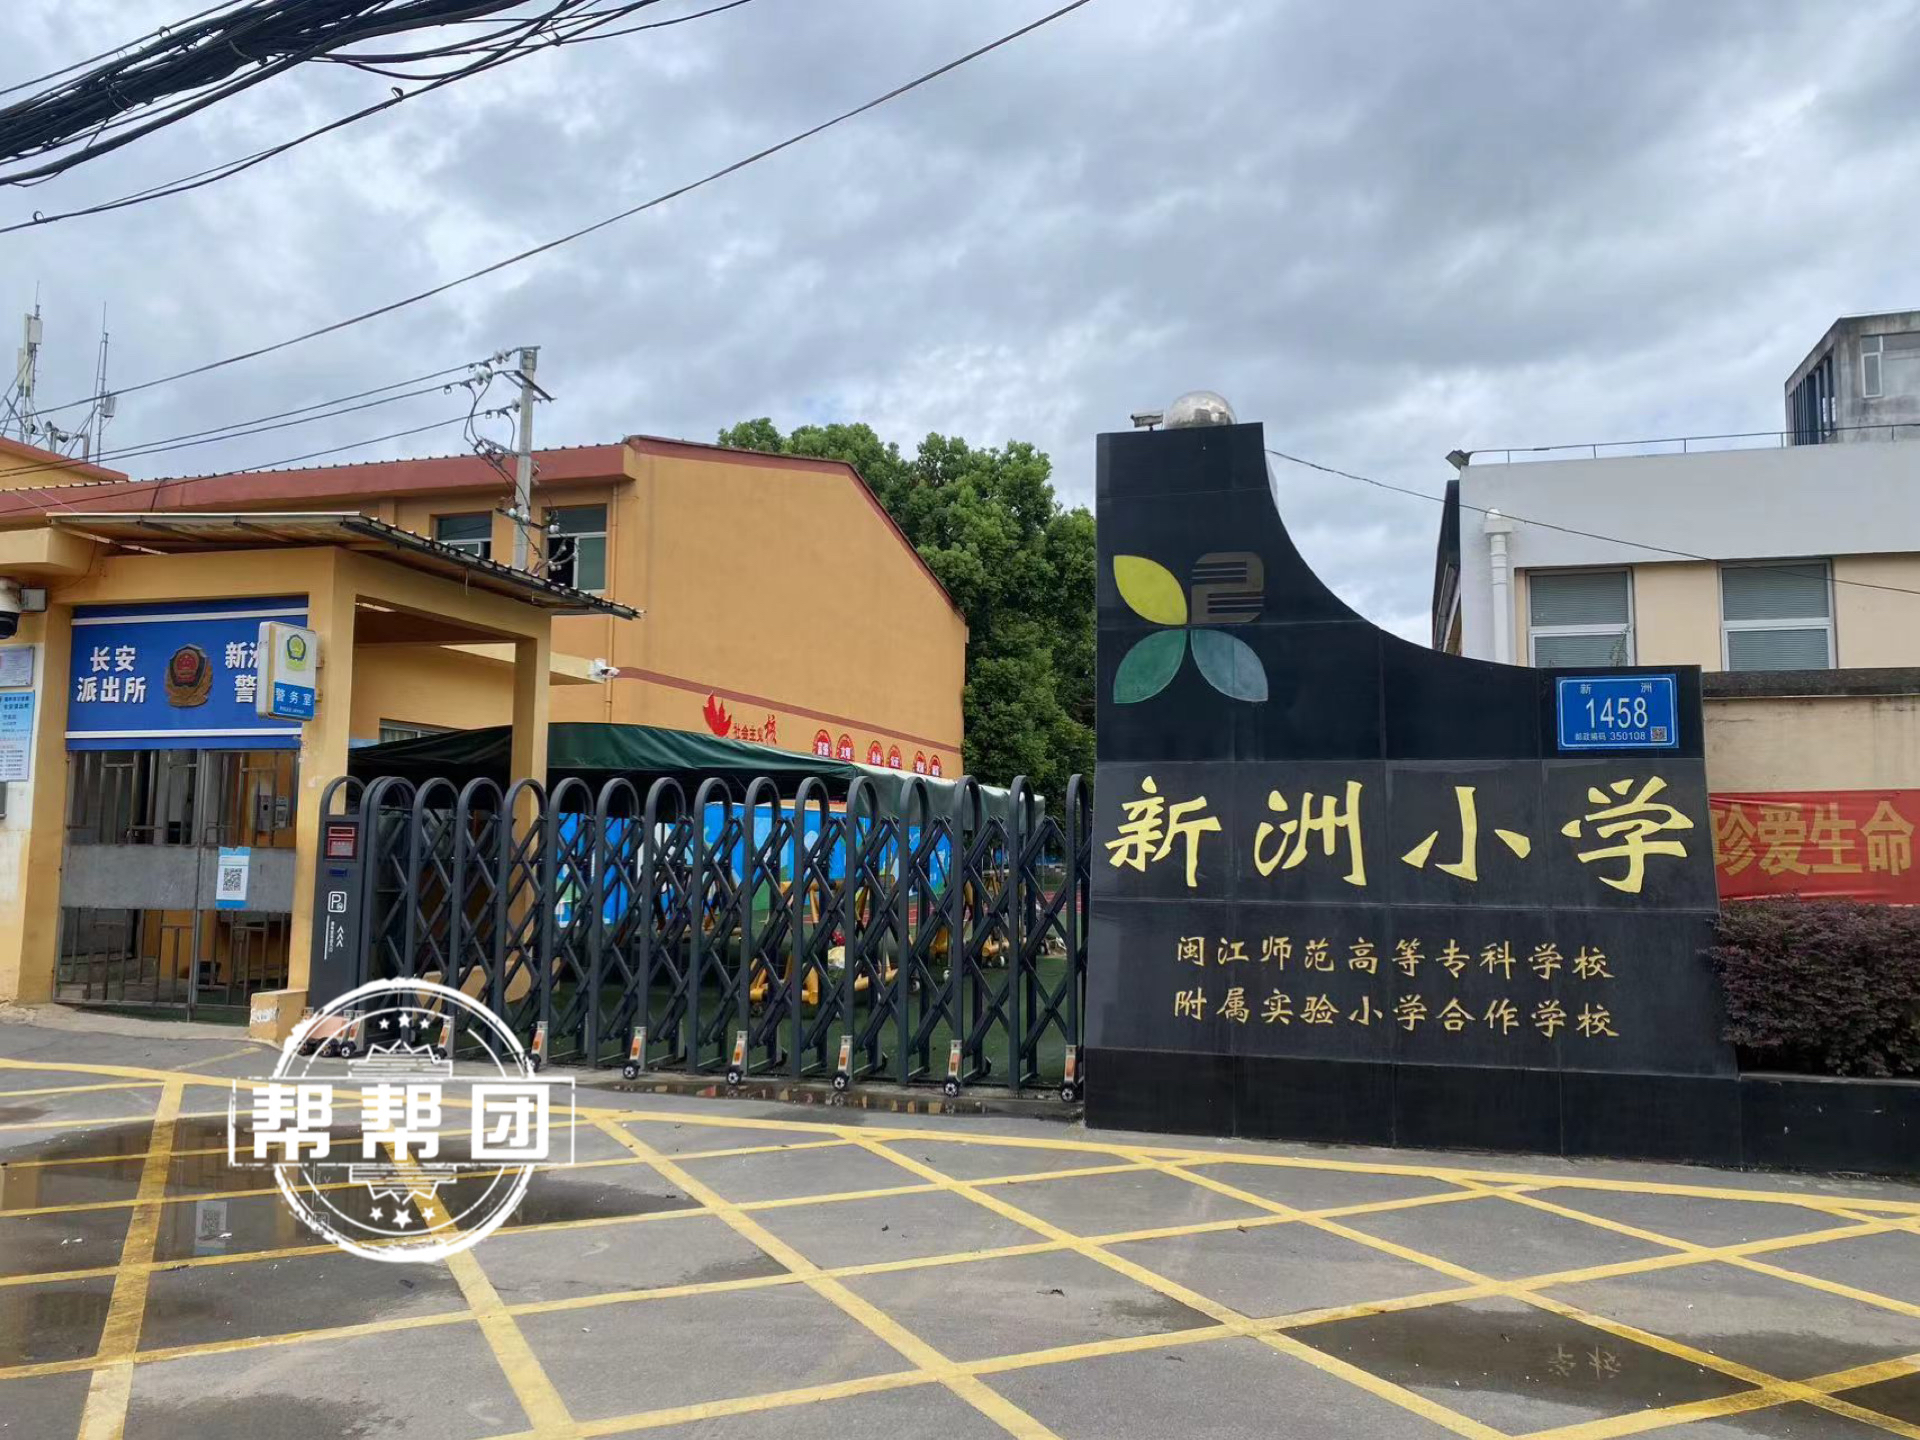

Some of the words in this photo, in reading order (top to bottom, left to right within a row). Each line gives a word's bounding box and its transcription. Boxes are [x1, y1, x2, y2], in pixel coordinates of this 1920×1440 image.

[90, 646, 136, 673] 长安
[76, 676, 146, 704] 派出所
[275, 687, 312, 706] 警务室
[1586, 697, 1648, 729] 1458
[1610, 731, 1646, 741] 350108
[1105, 775, 1694, 894] 新洲小学
[1711, 801, 1915, 876] 珍爱生命
[1176, 936, 1615, 980] 闽江师范高等专科学校
[1174, 987, 1619, 1039] 附属实验小学合作学校
